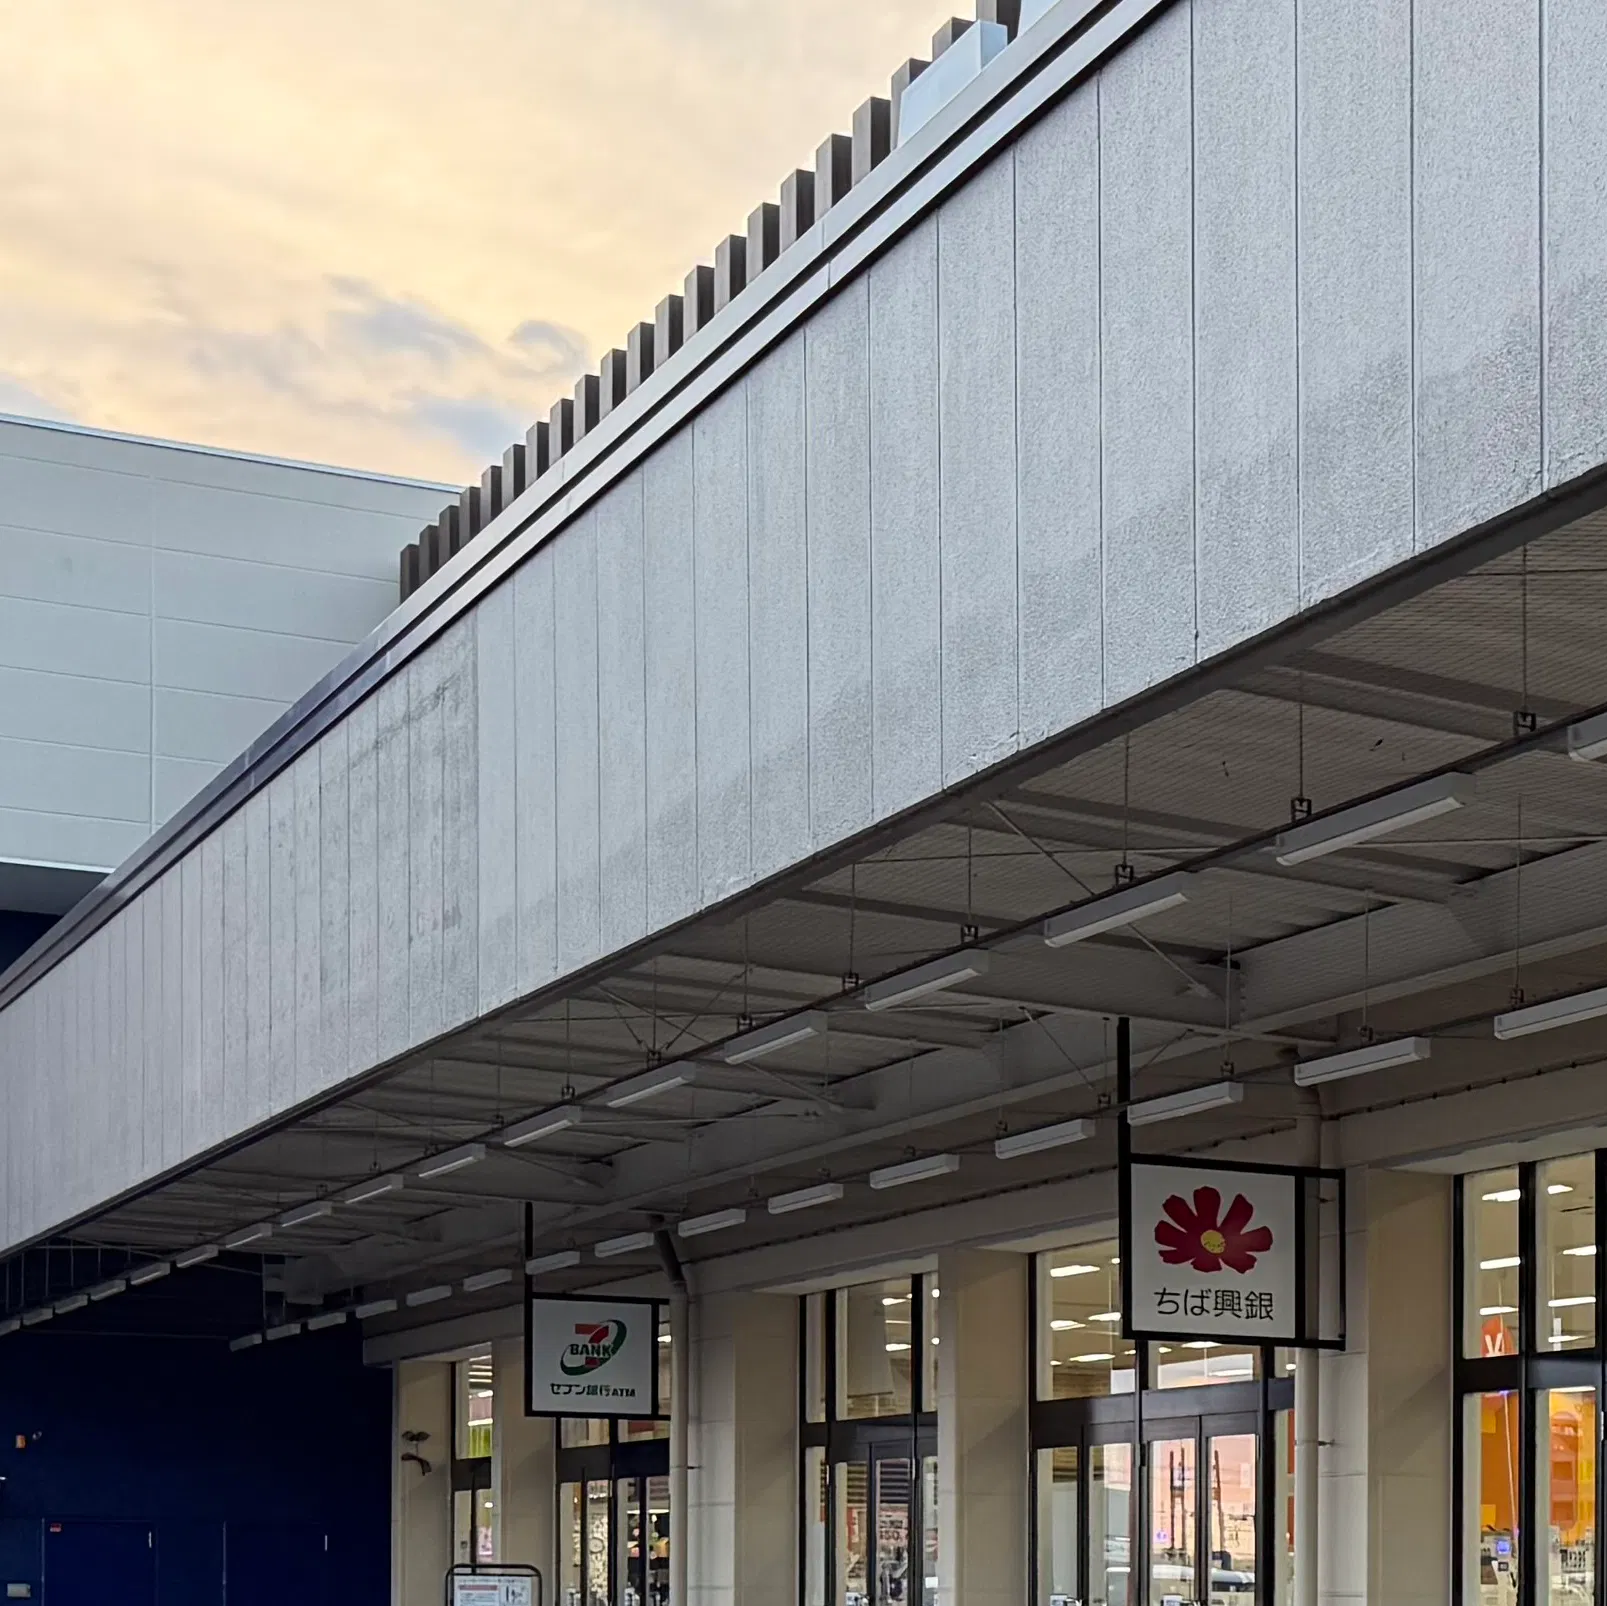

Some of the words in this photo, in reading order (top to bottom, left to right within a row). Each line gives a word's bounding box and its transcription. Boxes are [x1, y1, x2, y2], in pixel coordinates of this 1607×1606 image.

[1153, 1287, 1274, 1321] ちば興銀
[570, 1343, 613, 1357] BANK
